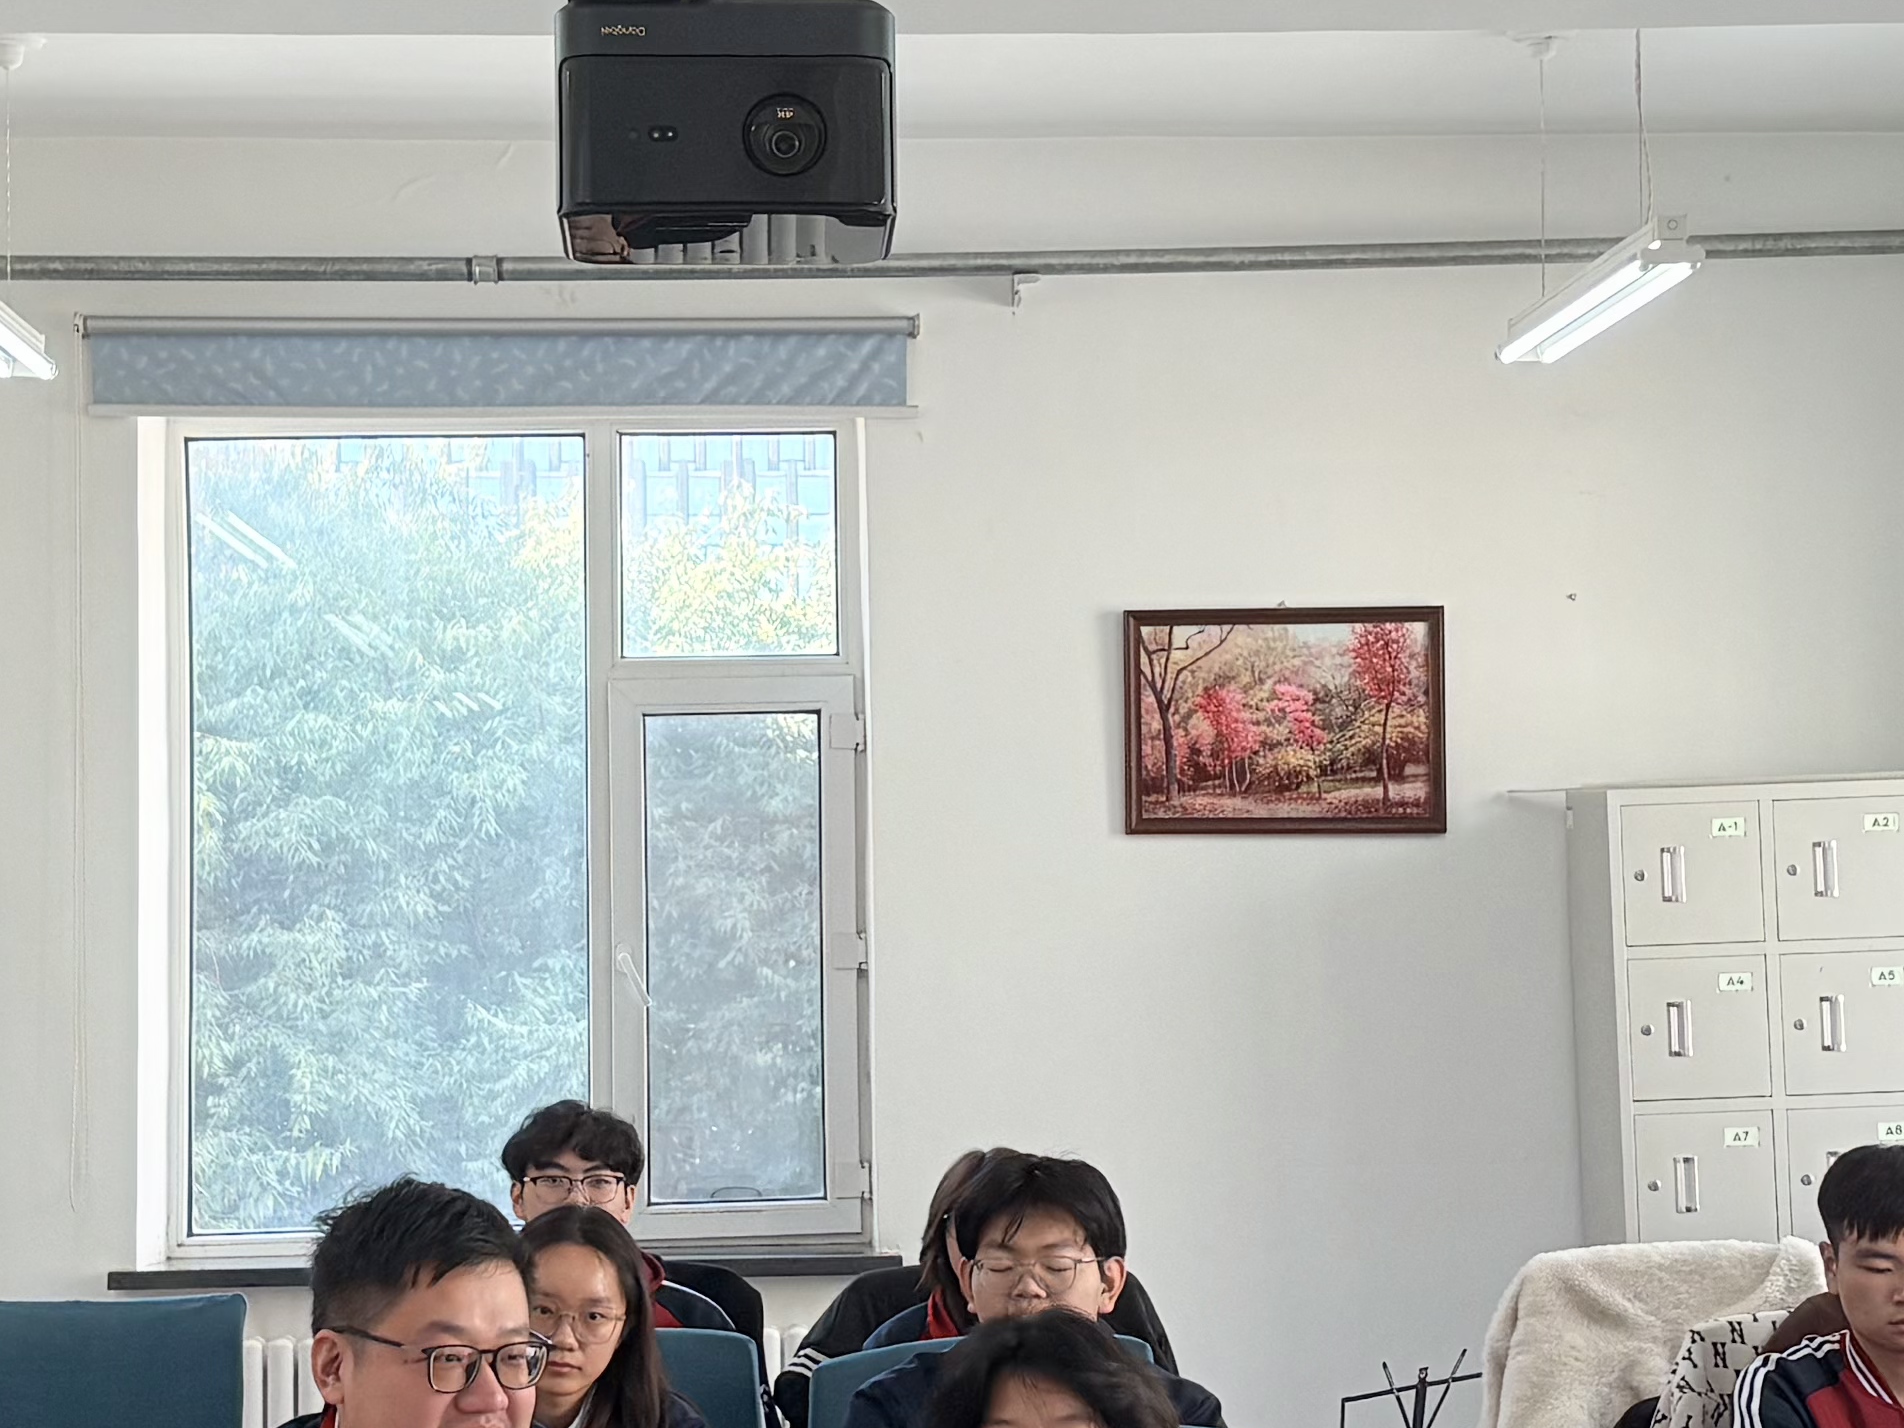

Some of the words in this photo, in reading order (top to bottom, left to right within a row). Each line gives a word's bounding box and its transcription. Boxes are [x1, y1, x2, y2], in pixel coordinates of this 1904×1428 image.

[1872, 816, 1890, 828] A2
[1726, 975, 1744, 987] A4
[1878, 969, 1896, 982] A5
[1885, 1123, 1903, 1136] A8
[1732, 1130, 1750, 1143] A7
